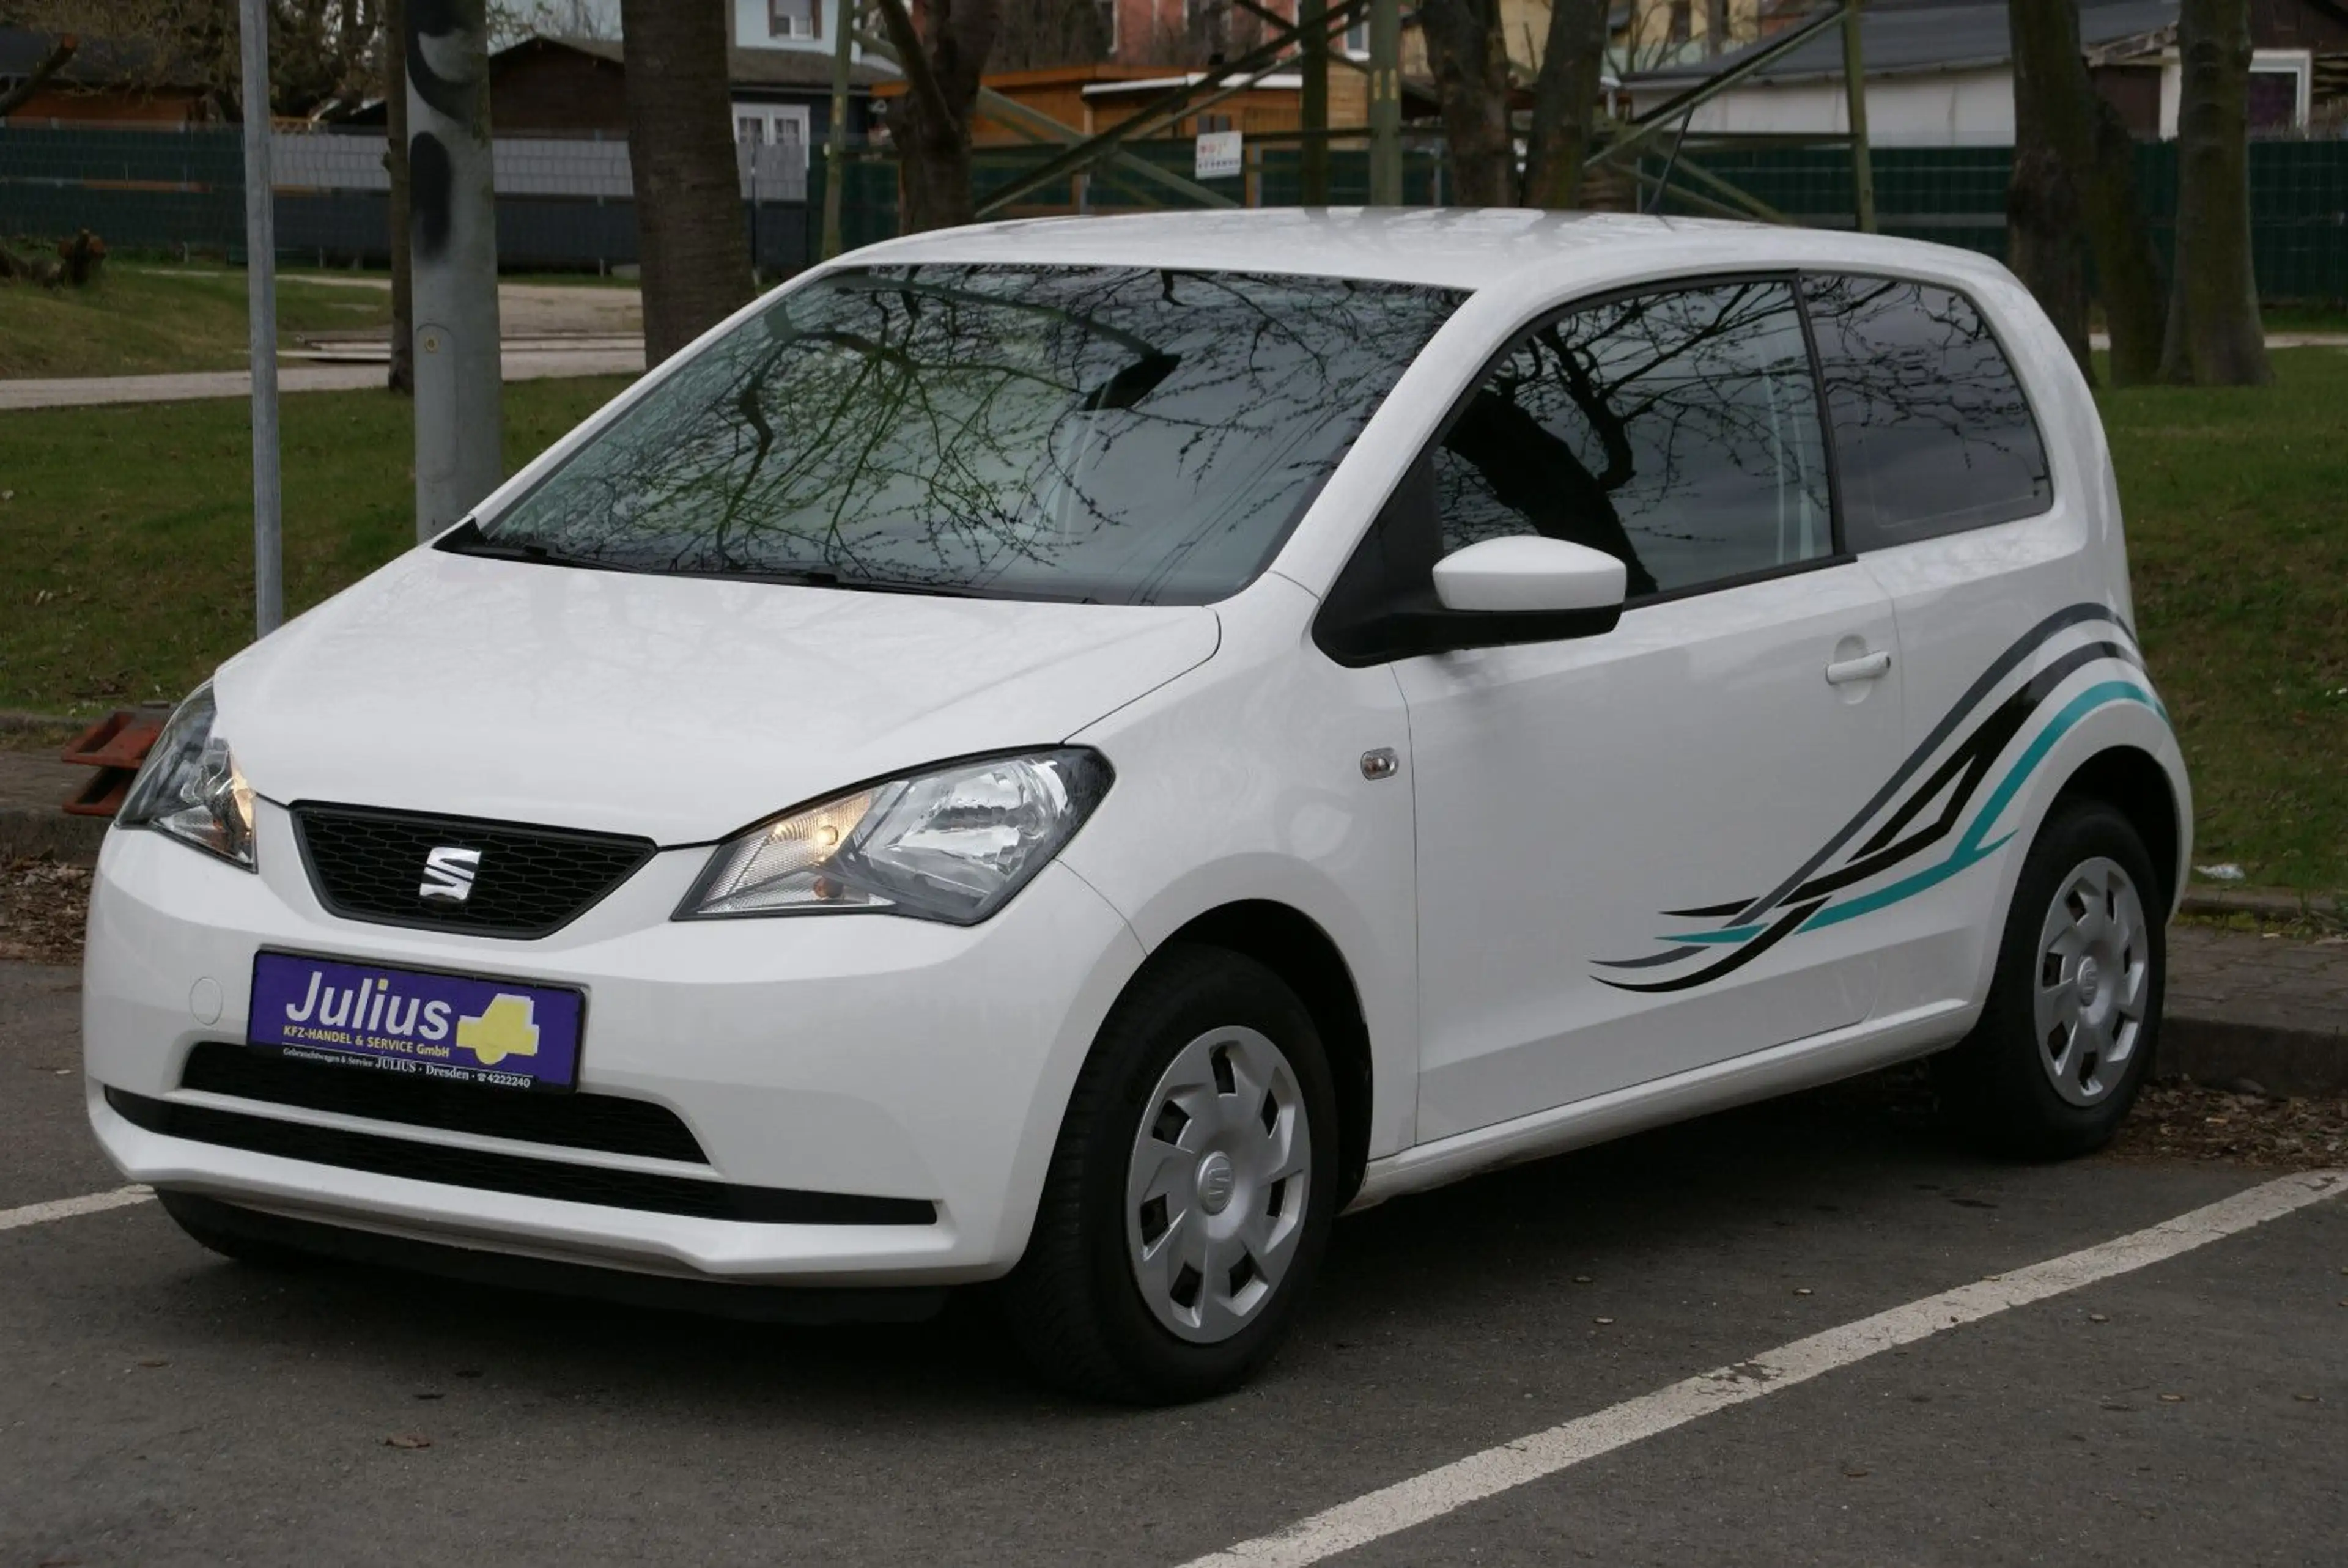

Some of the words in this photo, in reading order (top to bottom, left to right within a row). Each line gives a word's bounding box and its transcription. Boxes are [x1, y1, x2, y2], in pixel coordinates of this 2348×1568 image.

[286, 971, 451, 1040] Julius
[283, 1025, 352, 1044] KFZ-HANDEL
[355, 1035, 364, 1046] &
[367, 1037, 413, 1053] SERVICE
[416, 1043, 450, 1058] GmbH
[375, 1057, 416, 1073] JULIUS
[425, 1064, 470, 1080] Dresden
